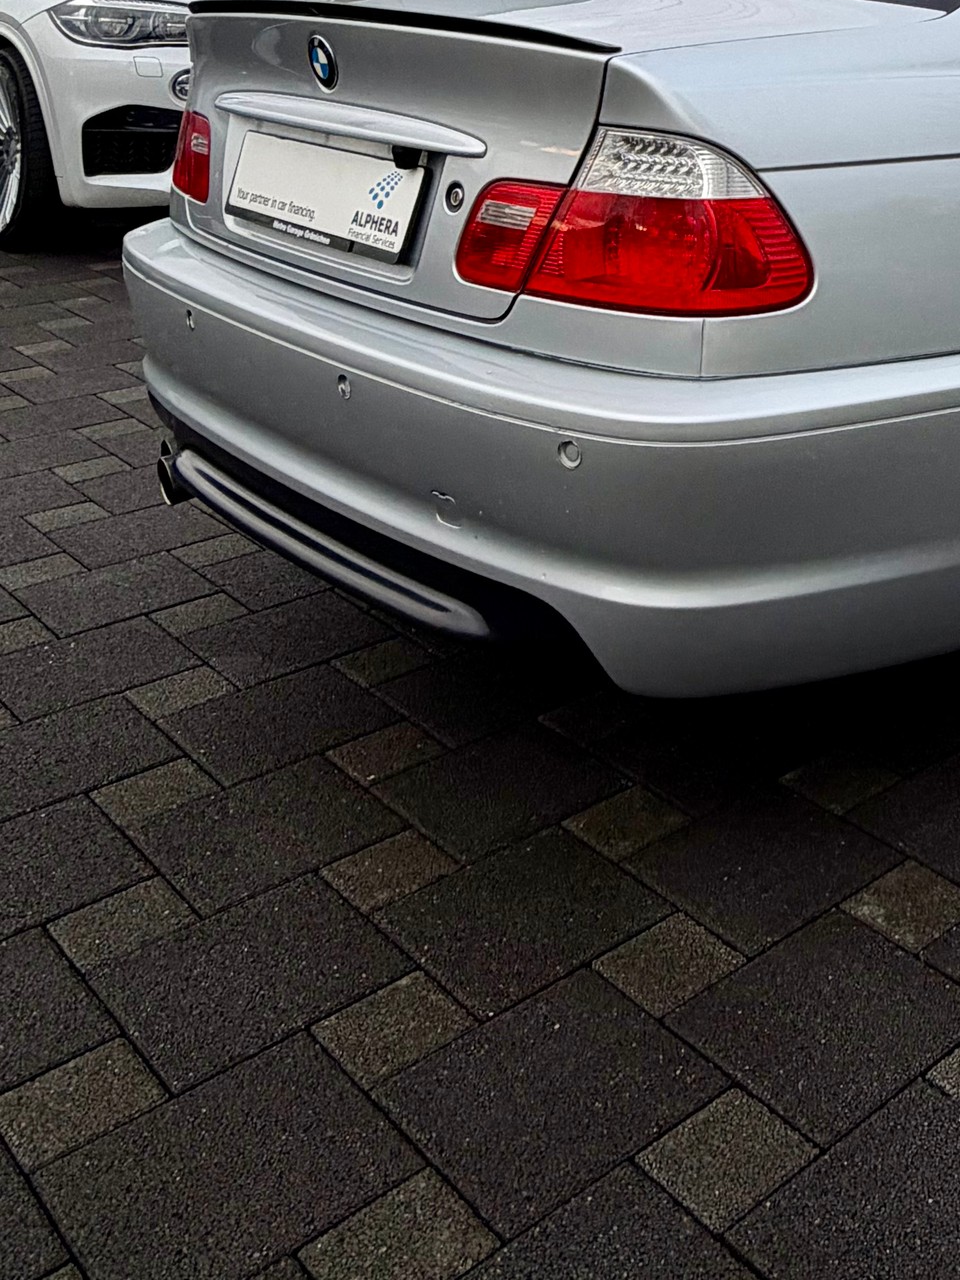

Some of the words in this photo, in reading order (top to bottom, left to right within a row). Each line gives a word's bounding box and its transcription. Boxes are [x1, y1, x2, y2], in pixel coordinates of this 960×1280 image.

[237, 187, 249, 200] Your
[249, 193, 271, 206] partner
[277, 200, 288, 211] car
[351, 210, 399, 237] ALPHERA
[348, 228, 372, 242] Financial
[371, 234, 395, 249] Services
